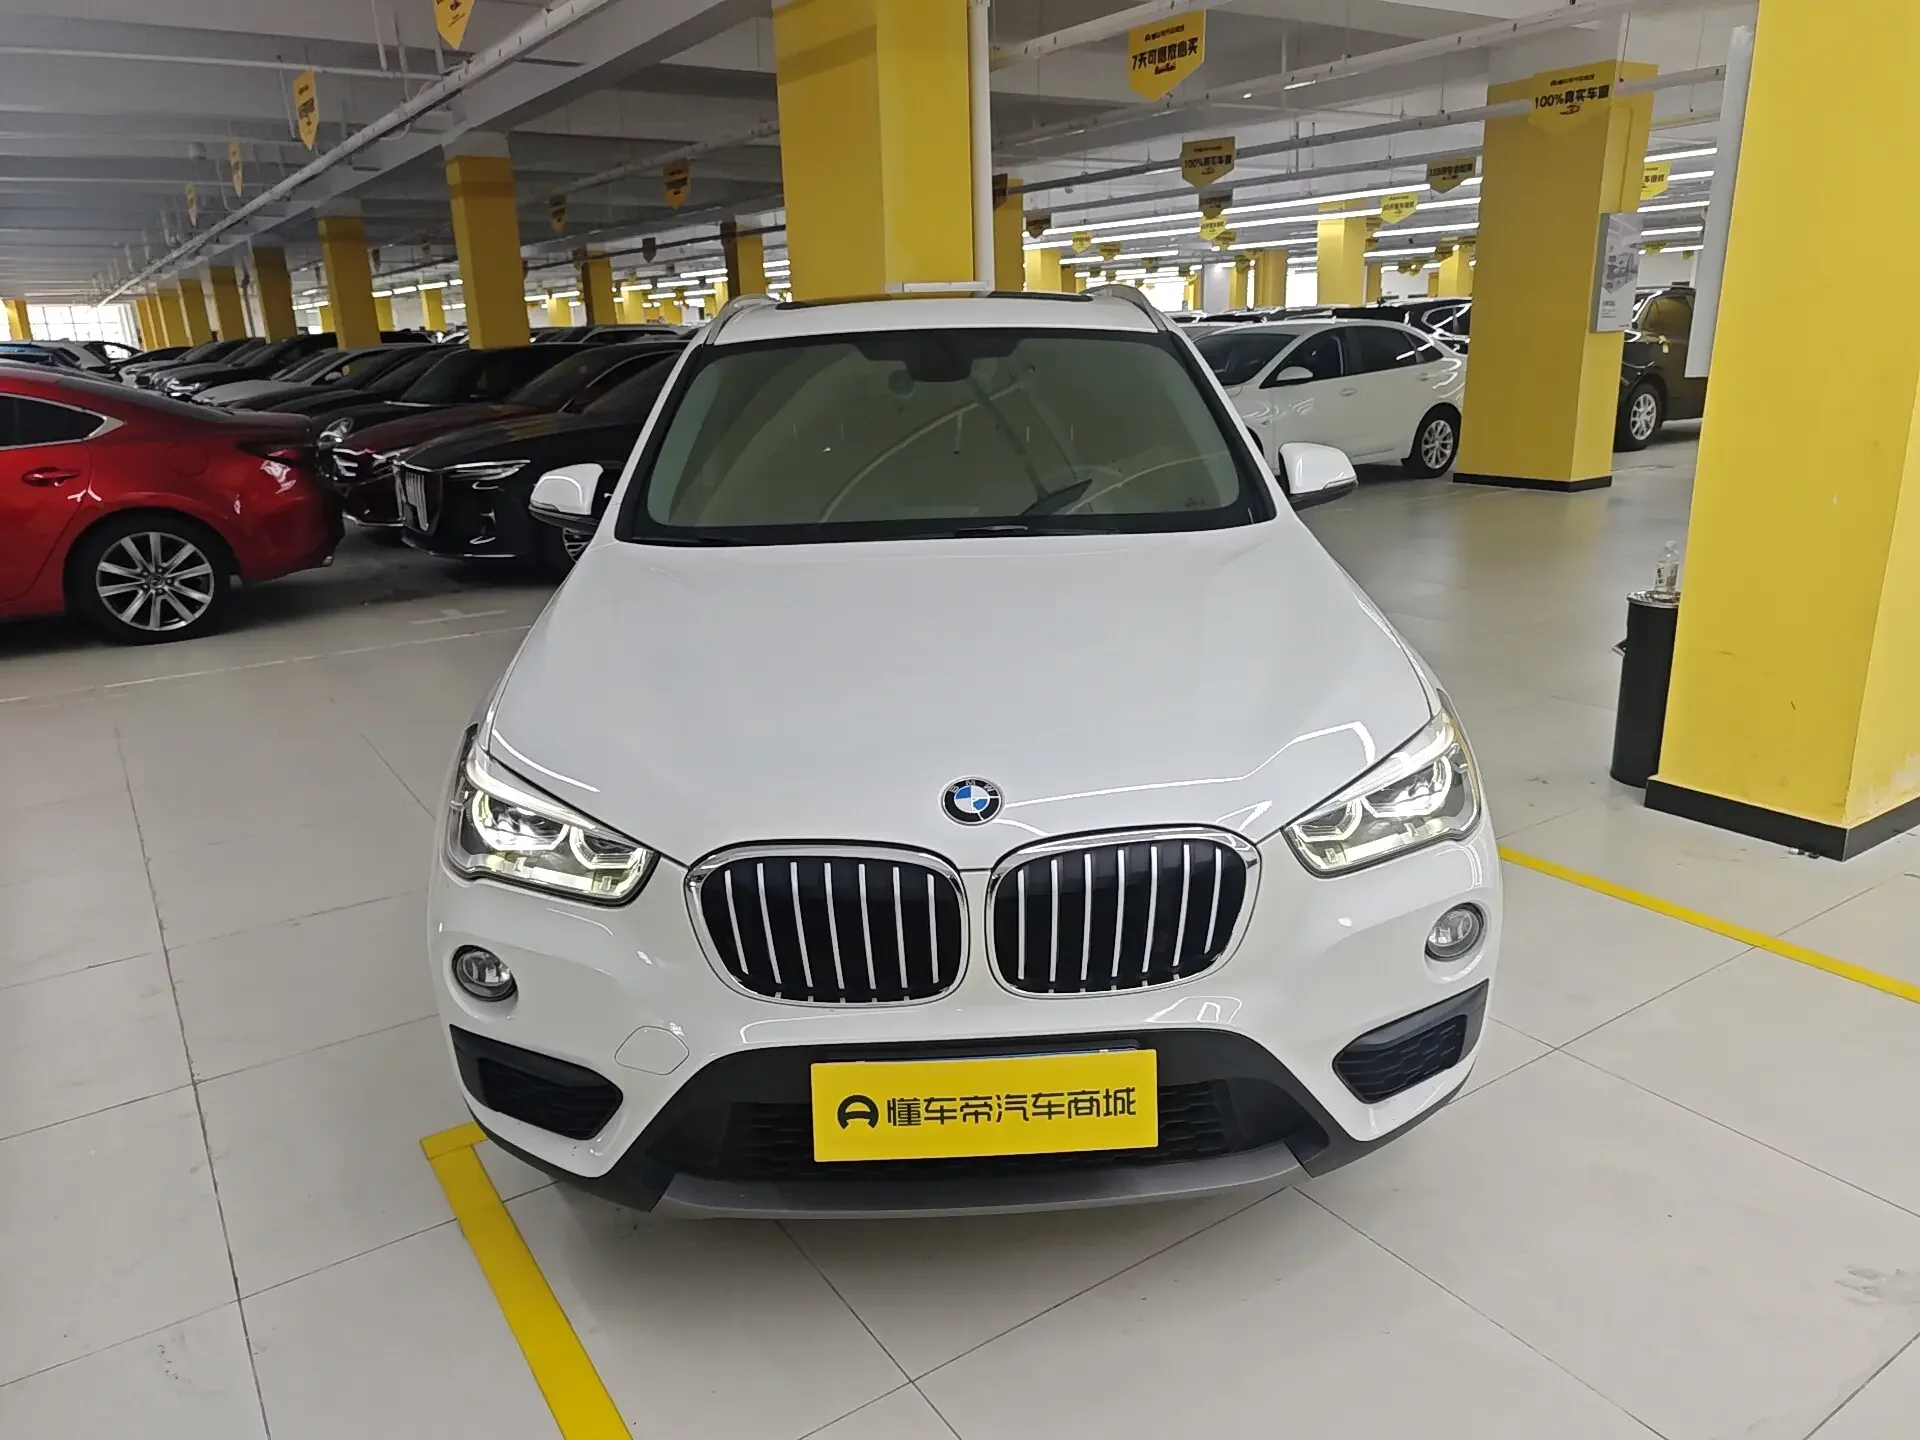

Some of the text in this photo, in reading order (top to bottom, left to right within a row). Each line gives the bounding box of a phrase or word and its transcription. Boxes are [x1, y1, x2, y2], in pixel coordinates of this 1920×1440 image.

[949, 780, 995, 793] BMW
[887, 1086, 1137, 1127] 懂车帝汽车商城
